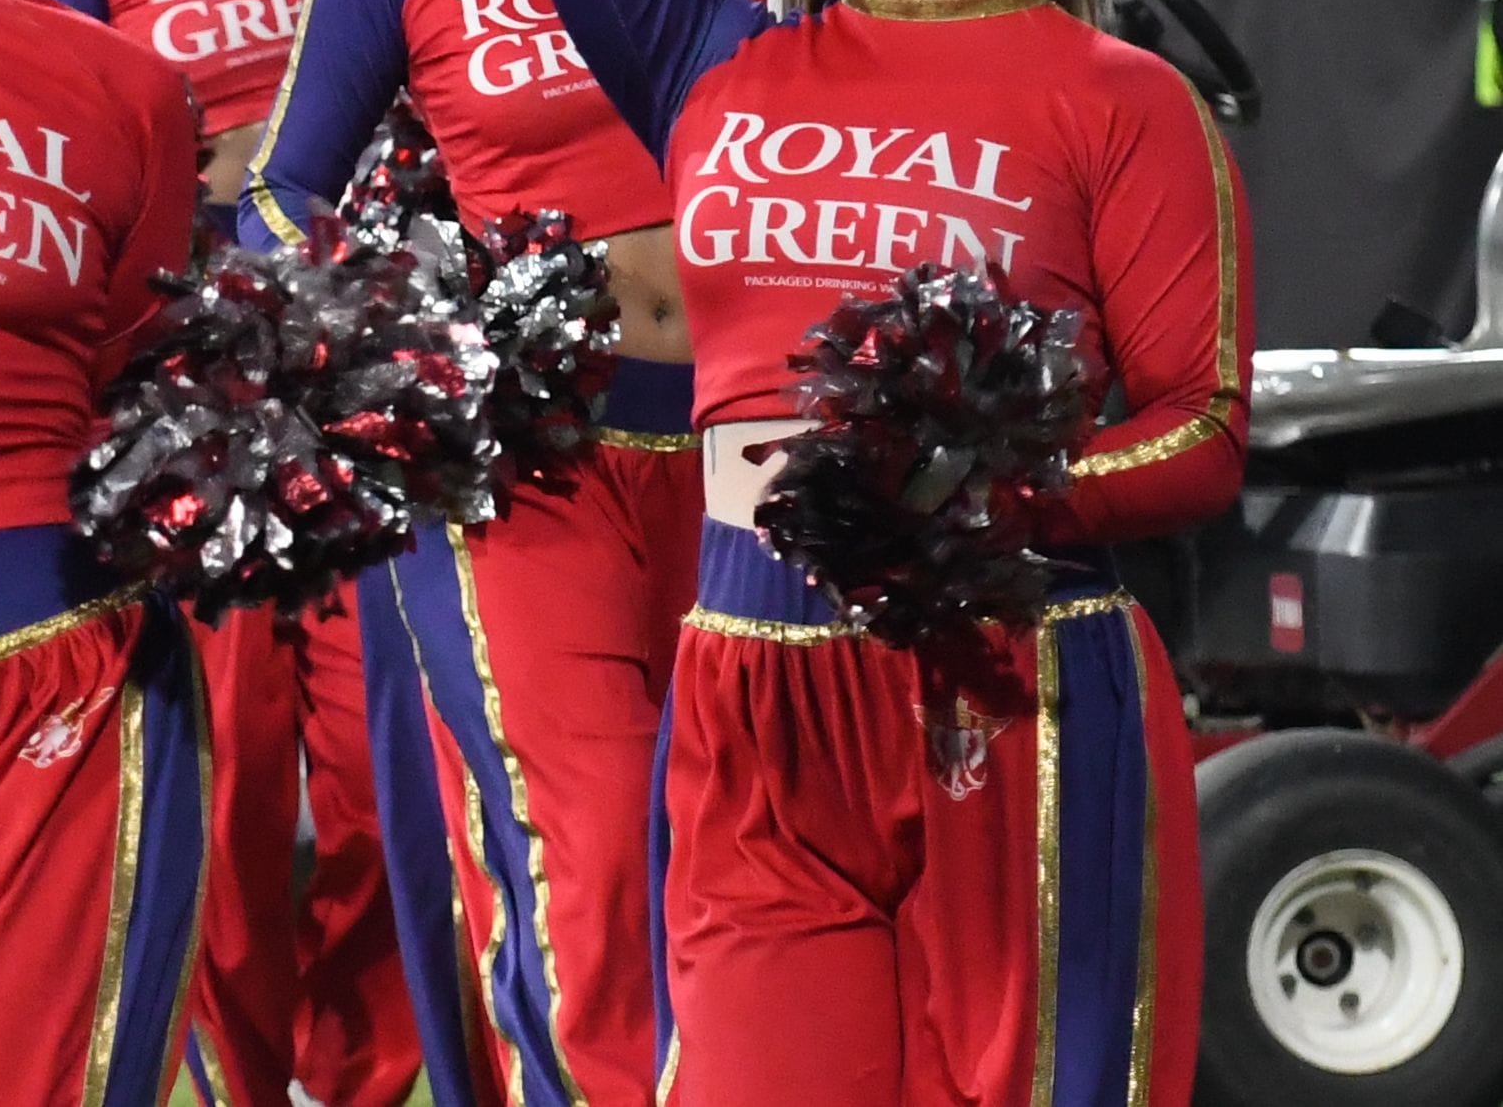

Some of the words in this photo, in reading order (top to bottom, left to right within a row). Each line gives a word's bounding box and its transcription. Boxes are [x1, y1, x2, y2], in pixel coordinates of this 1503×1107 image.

[696, 111, 1032, 212] ROYAL
[679, 185, 1024, 277] GREEN
[744, 275, 813, 288] PACKAGED
[815, 278, 877, 293] DRINKING
